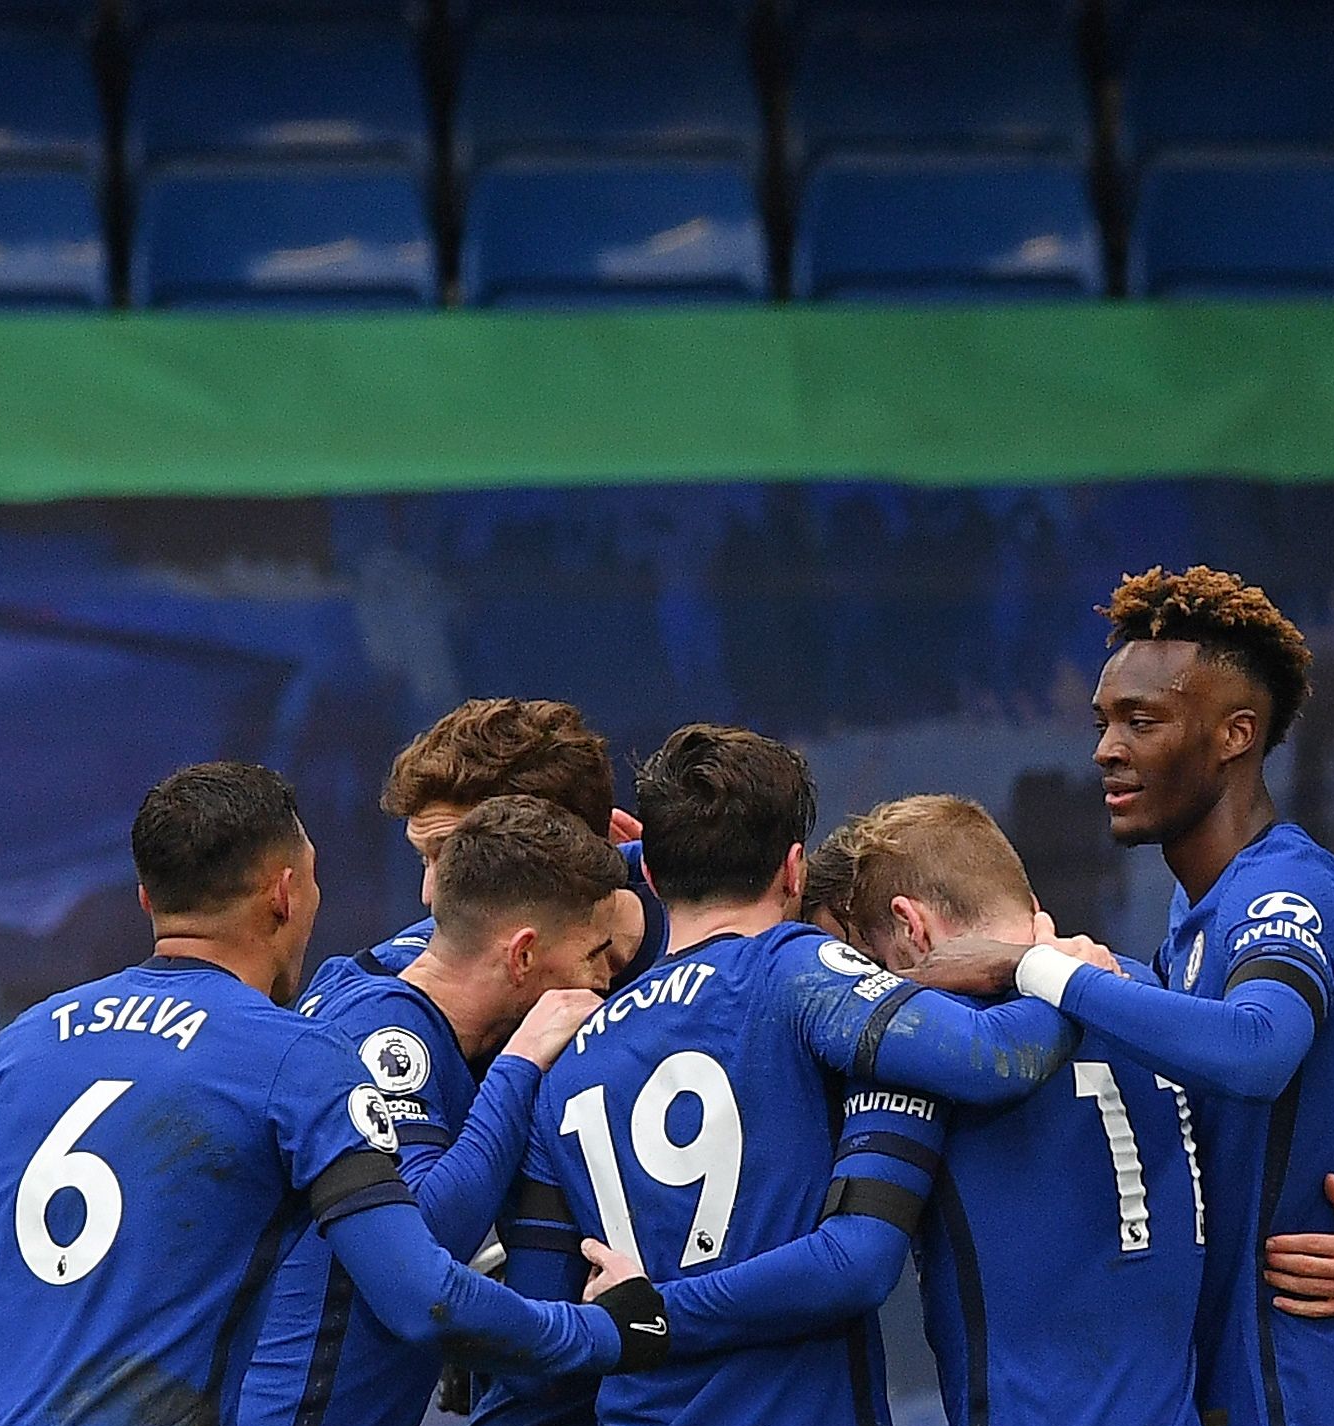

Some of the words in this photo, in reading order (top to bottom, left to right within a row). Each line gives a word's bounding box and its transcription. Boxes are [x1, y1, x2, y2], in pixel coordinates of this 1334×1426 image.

[51, 995, 208, 1050] T.SILVA
[15, 1079, 135, 1286] 6
[559, 1050, 743, 1277] 19
